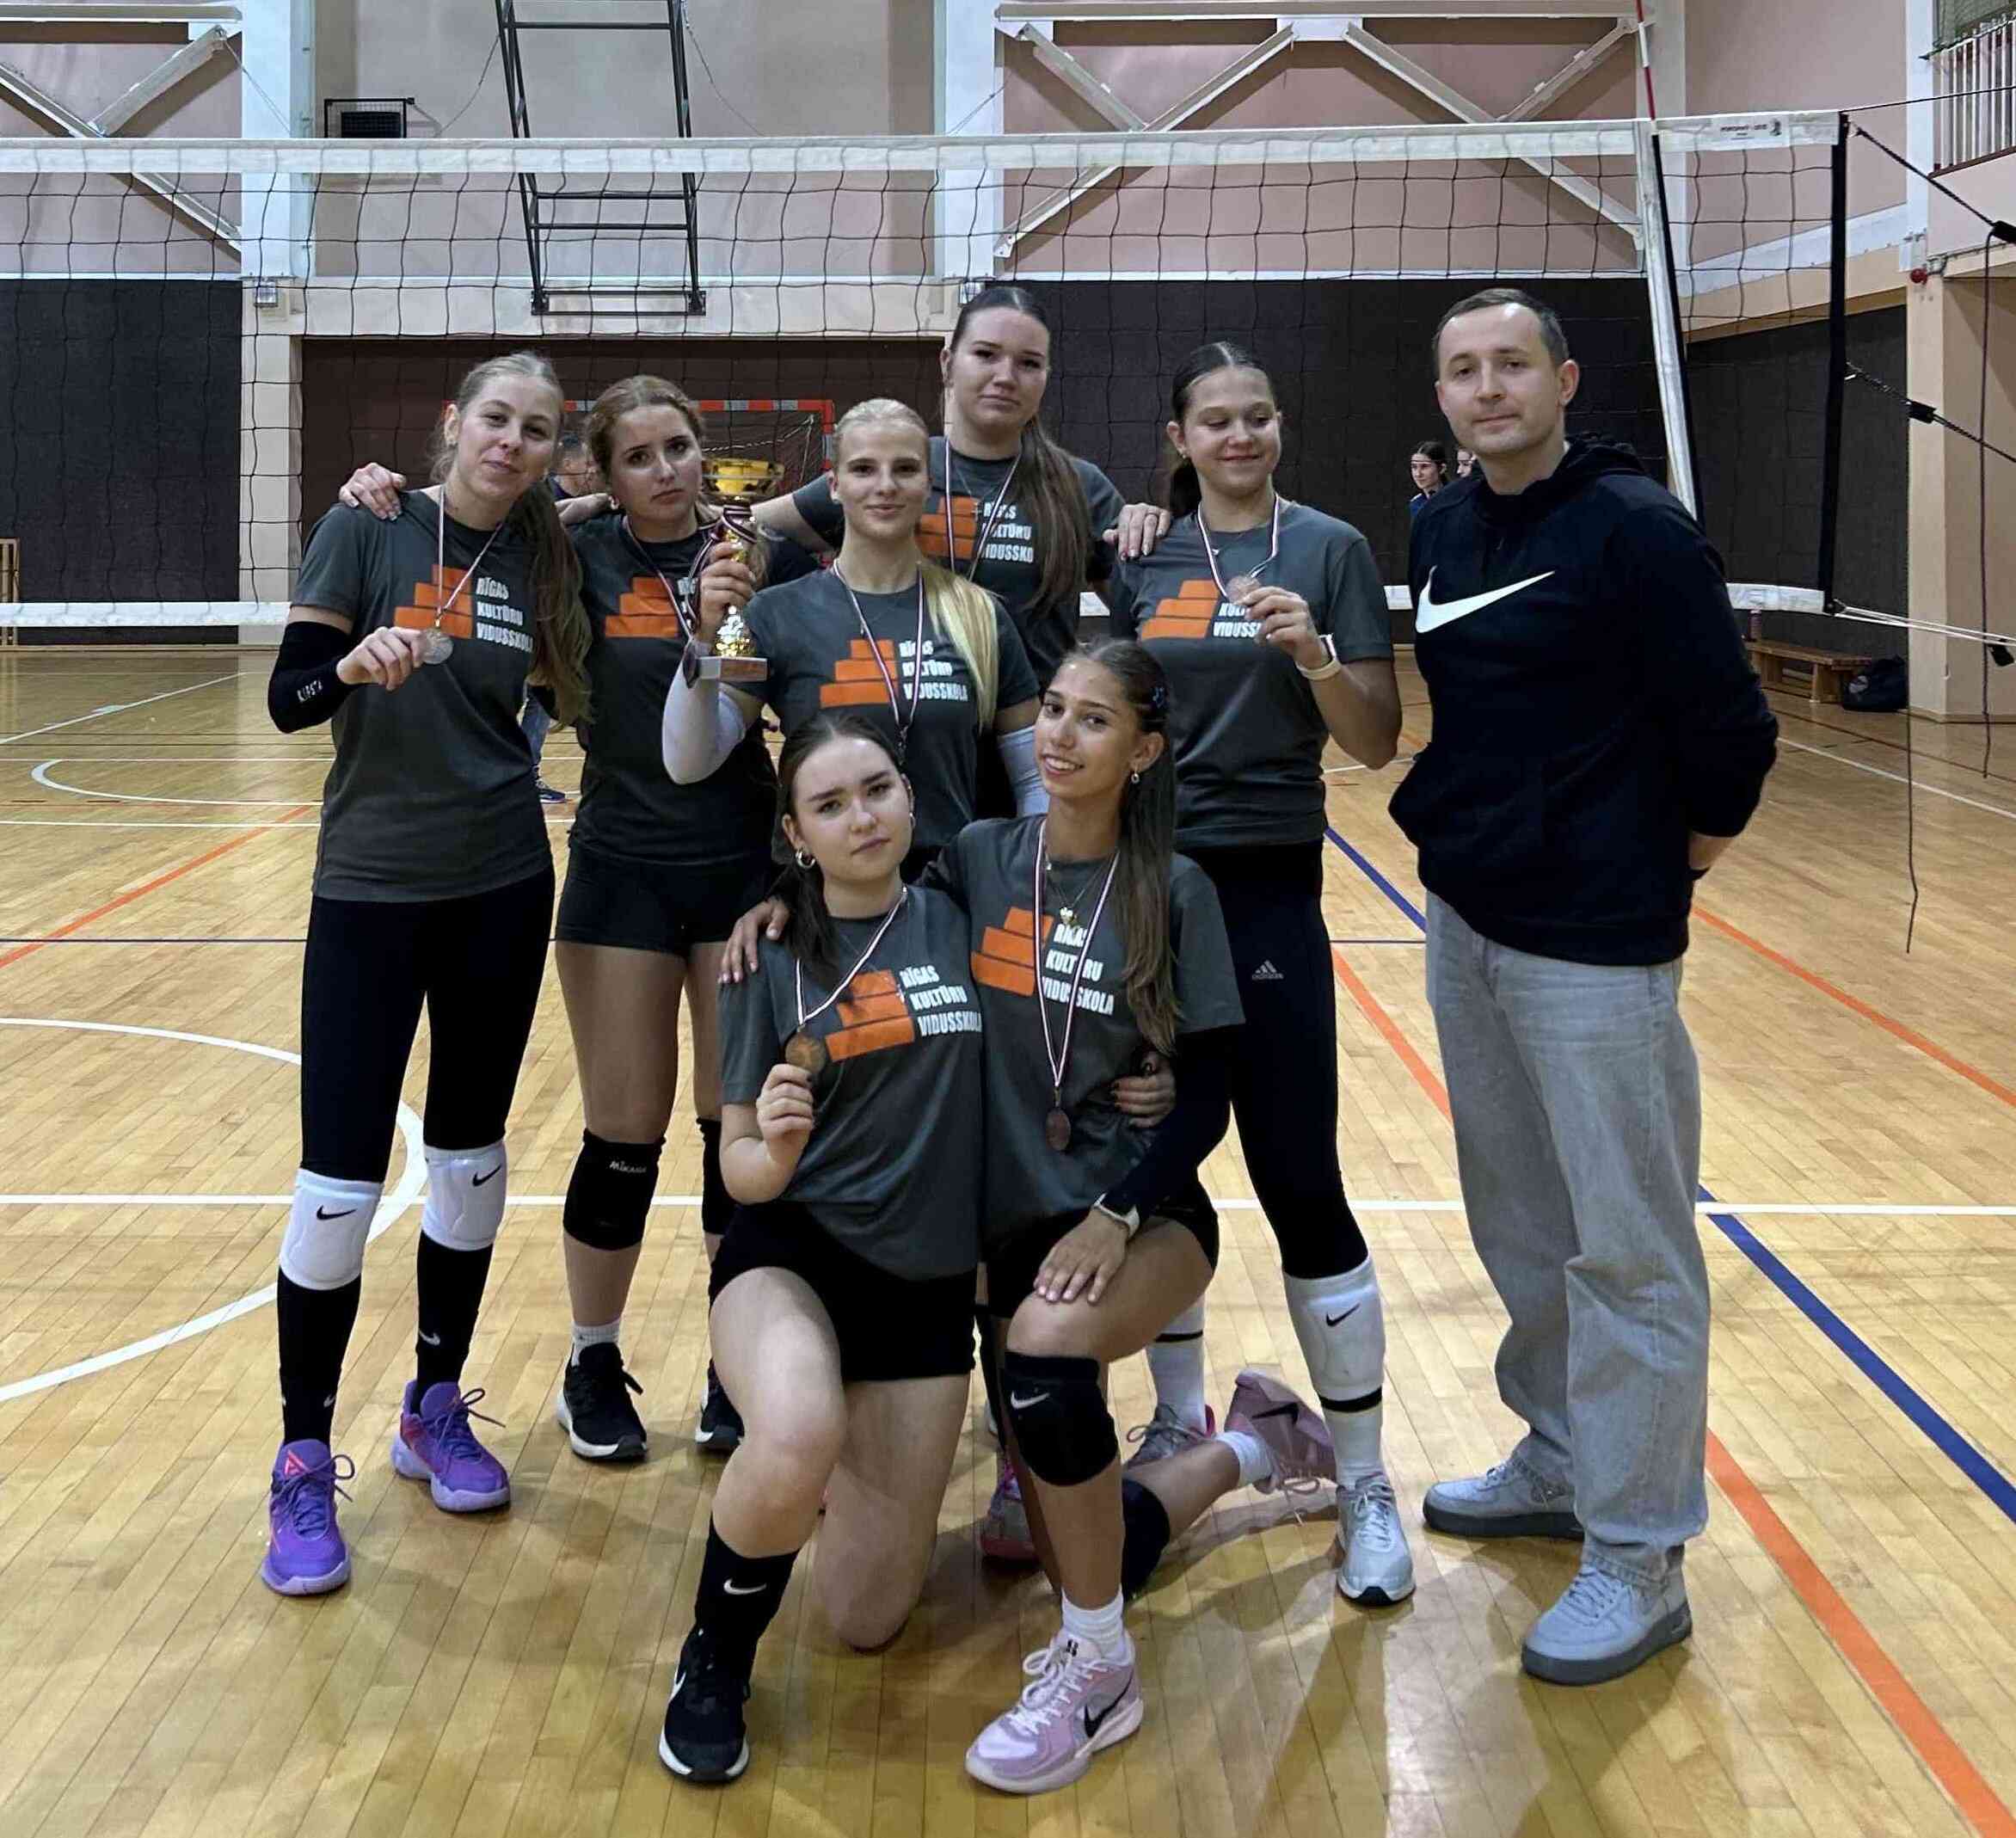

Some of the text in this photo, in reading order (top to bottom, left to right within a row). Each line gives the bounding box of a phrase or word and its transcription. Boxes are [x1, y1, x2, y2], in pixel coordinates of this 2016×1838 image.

[1214, 622, 1263, 637] VIDUSS
[901, 659, 954, 678] KUTŪRU
[1045, 949, 1104, 981] KULTRU
